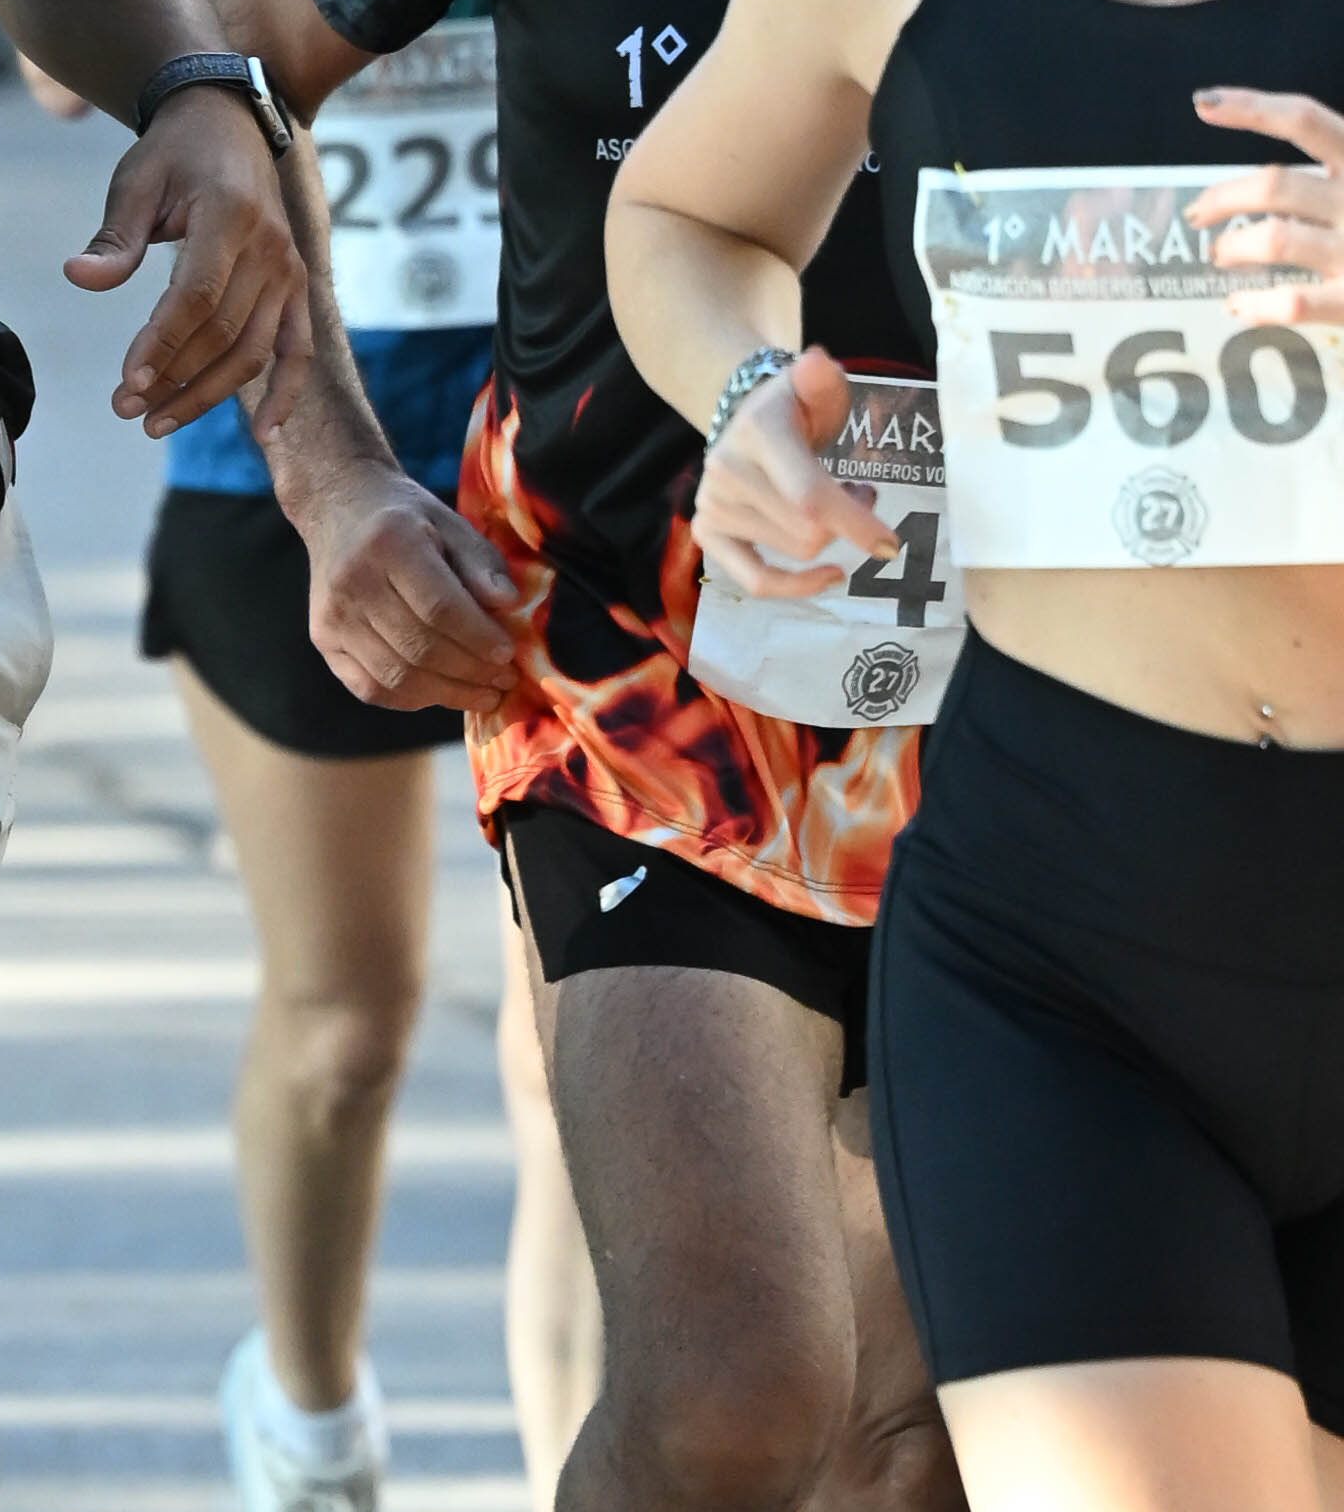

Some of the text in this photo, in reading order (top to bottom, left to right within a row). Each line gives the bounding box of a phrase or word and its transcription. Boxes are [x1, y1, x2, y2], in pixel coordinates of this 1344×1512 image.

[989, 325, 1327, 449] 560
[837, 458, 922, 482] BOMBEROS
[868, 668, 900, 694] 27
